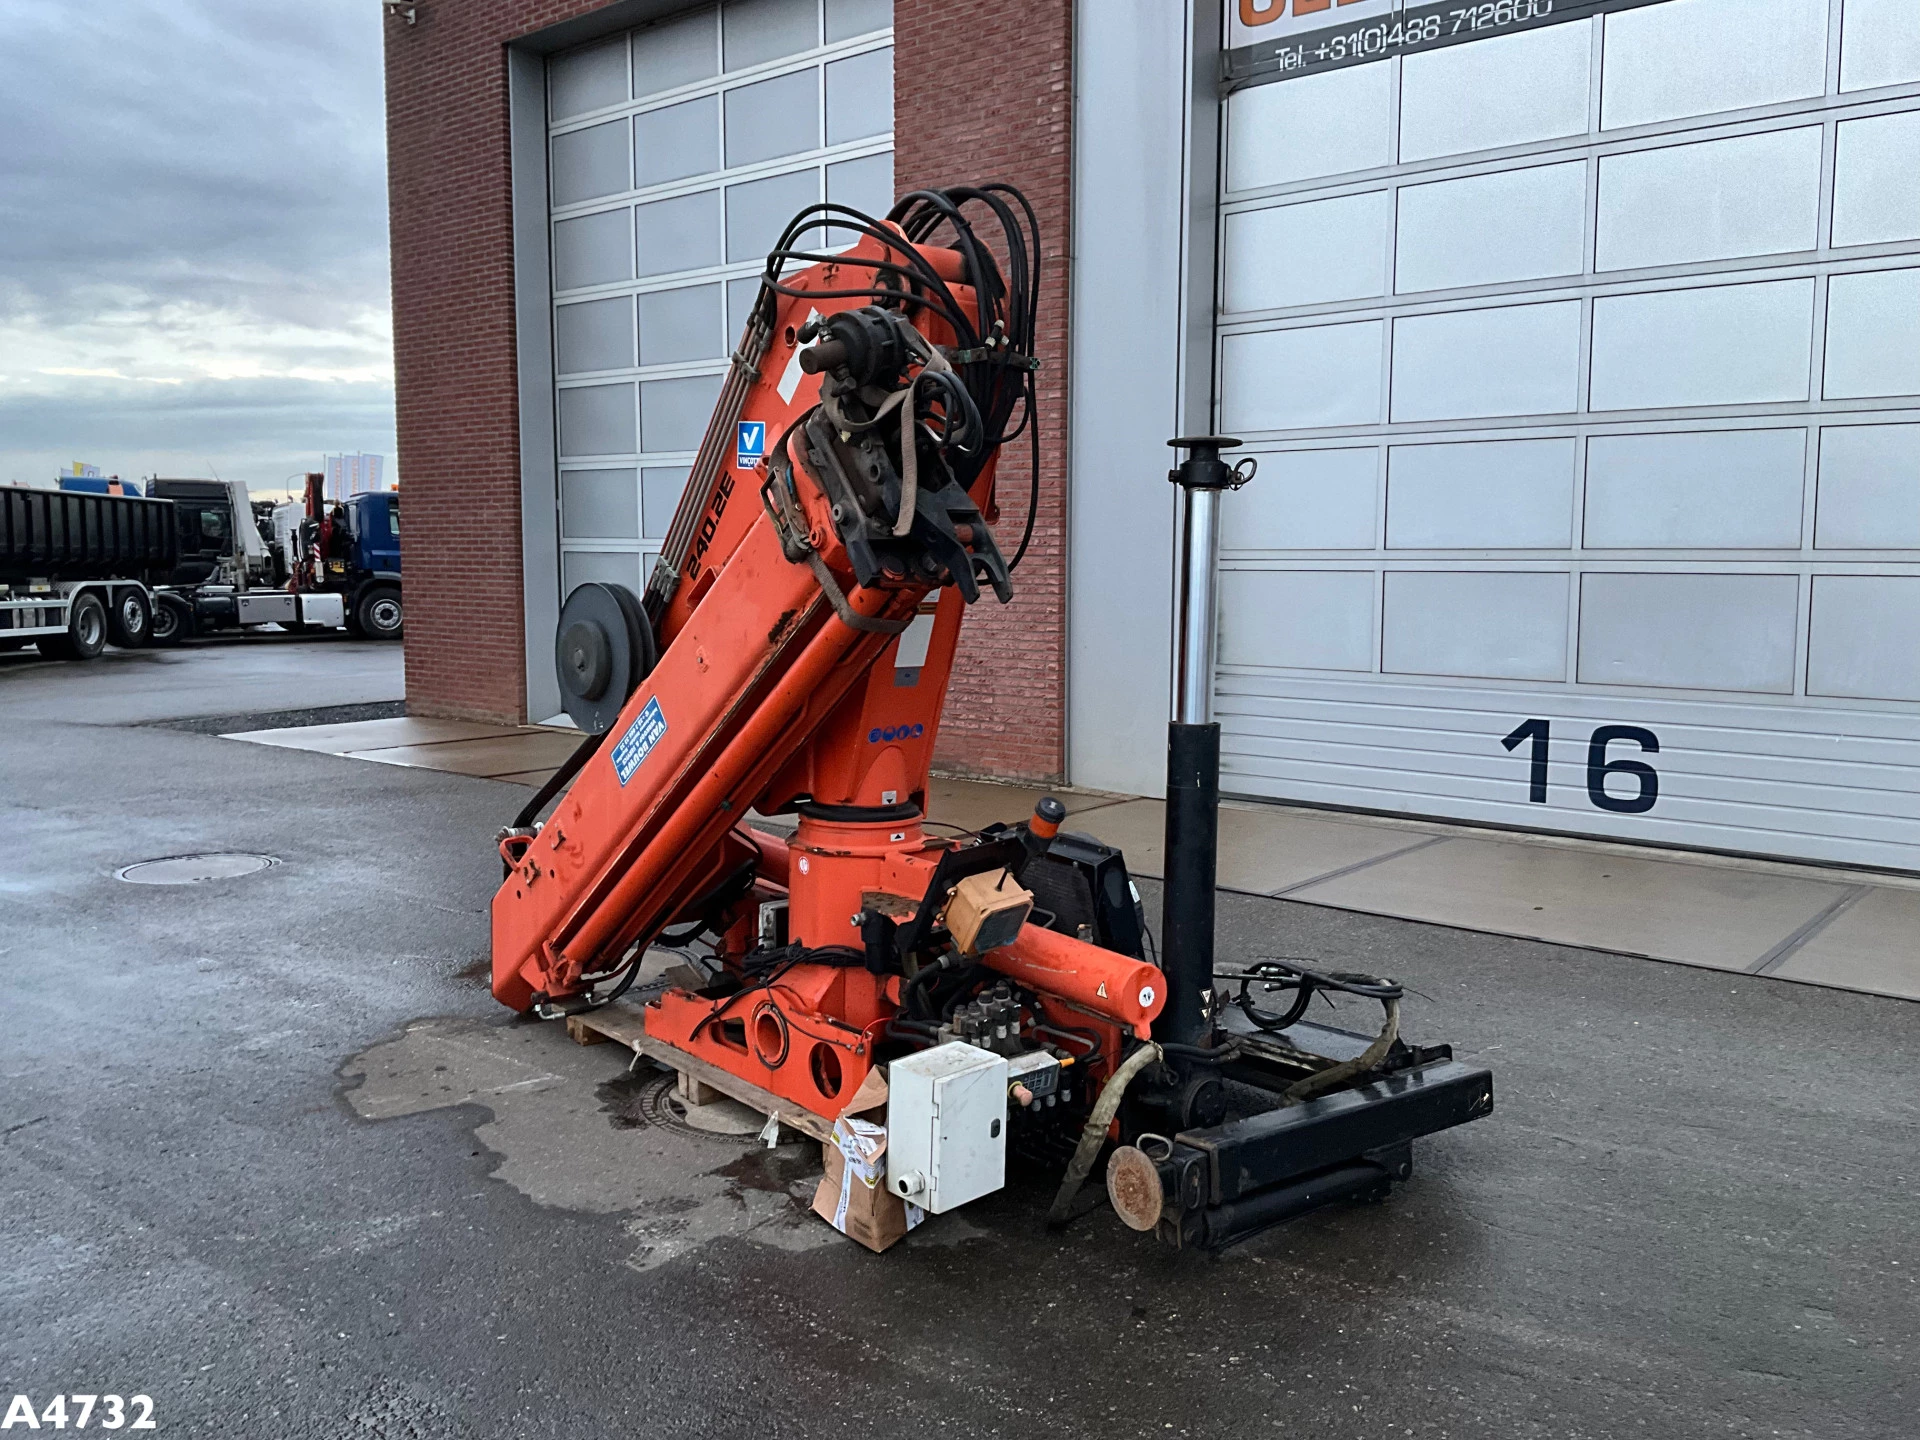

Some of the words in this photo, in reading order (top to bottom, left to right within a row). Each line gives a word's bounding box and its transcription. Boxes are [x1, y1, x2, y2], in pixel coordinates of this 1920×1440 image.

[1315, 15, 1441, 59] +31(0)488
[1449, 0, 1552, 35] 712600
[686, 471, 736, 581] 240.2E
[620, 740, 649, 780] BOUWEL
[647, 720, 665, 744] VAN
[1500, 719, 1660, 813] 16
